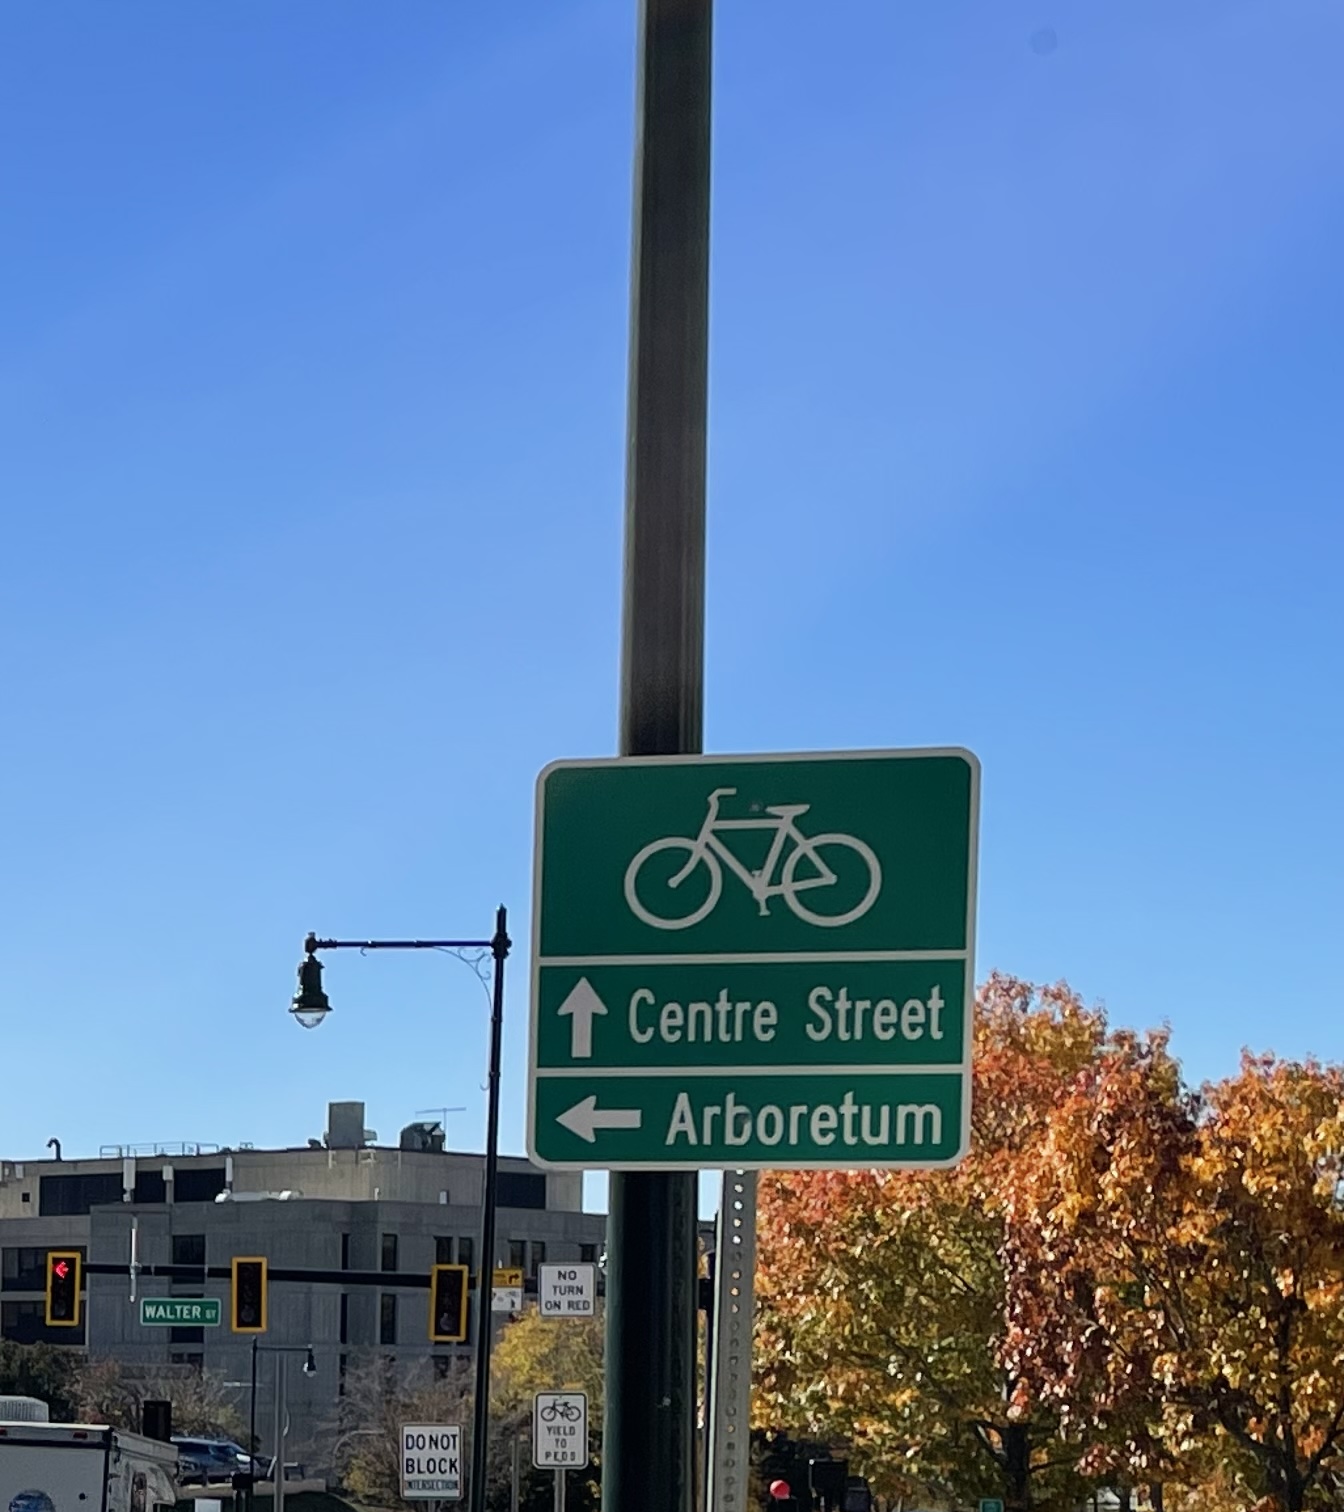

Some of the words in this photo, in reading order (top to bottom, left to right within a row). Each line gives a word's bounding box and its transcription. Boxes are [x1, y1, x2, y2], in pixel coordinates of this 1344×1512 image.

[628, 987, 778, 1045] Centre
[805, 984, 945, 1042] Street
[665, 1090, 942, 1147] Arboretum
[557, 1270, 577, 1281] NO
[552, 1285, 584, 1296] TURN
[544, 1300, 561, 1310] ON
[567, 1300, 590, 1310] RED
[145, 1305, 201, 1319] WALTER
[546, 1425, 576, 1436] YIELD
[405, 1434, 426, 1450] DO
[429, 1434, 458, 1450] NOT
[555, 1438, 567, 1448] TO
[545, 1451, 576, 1461] PEDS
[405, 1458, 459, 1474] BLOCK
